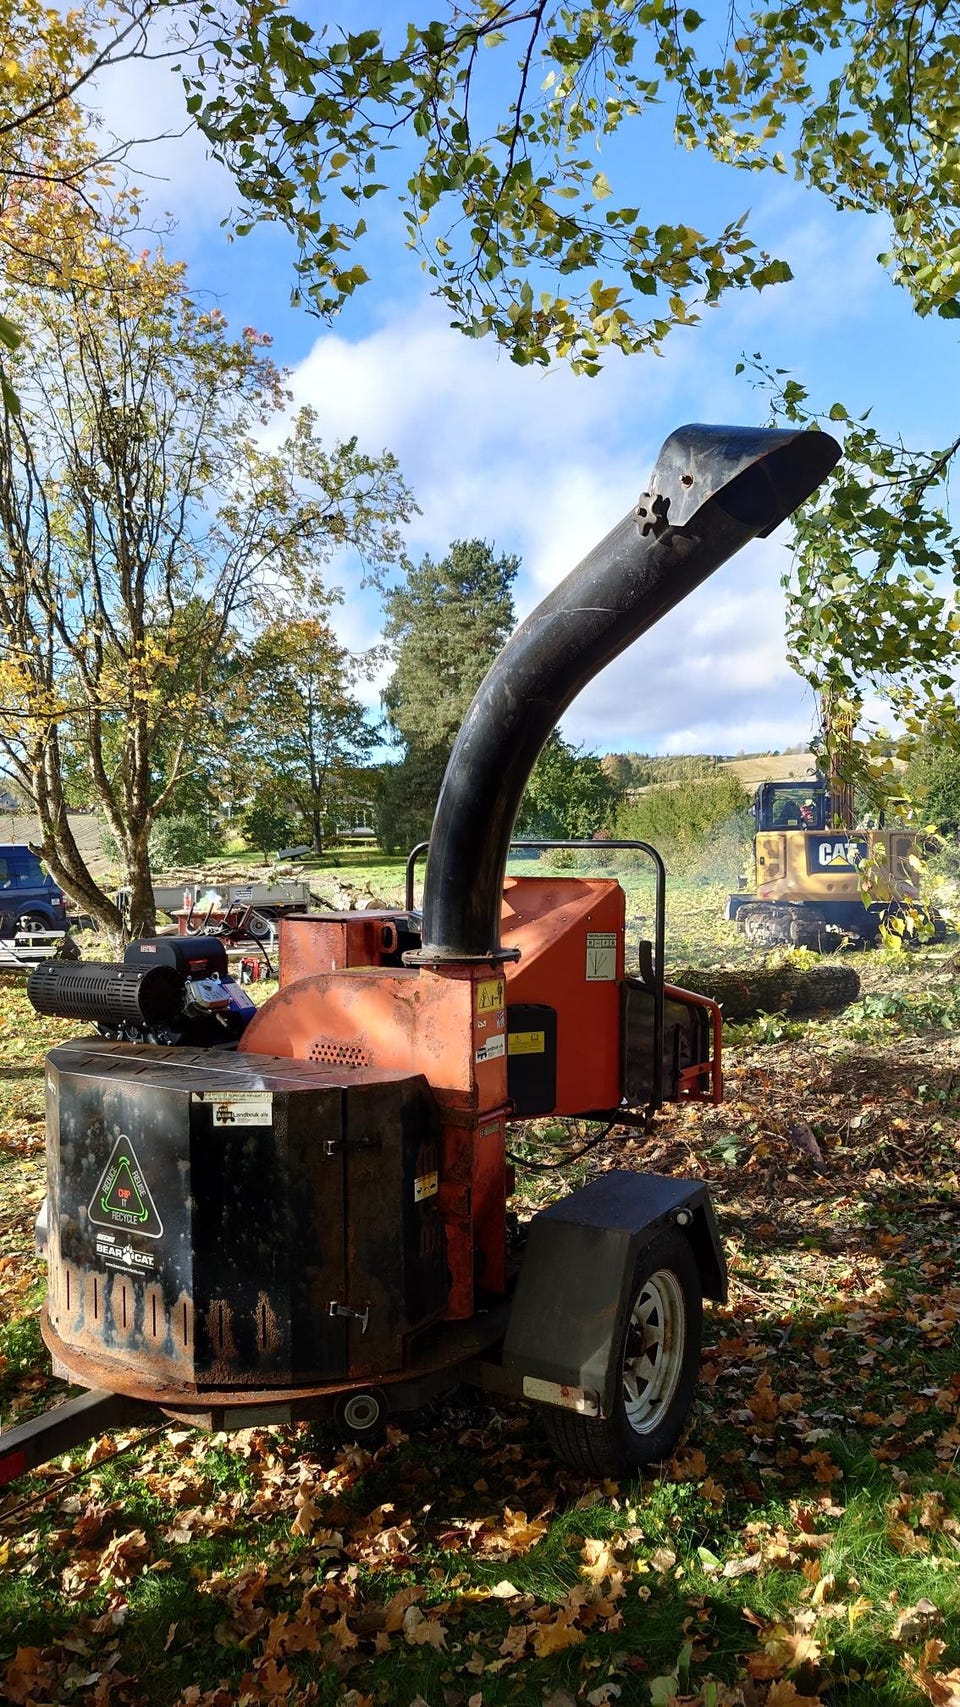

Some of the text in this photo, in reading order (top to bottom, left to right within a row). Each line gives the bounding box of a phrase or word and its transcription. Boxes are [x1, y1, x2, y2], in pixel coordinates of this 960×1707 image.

[132, 1170, 147, 1198] REUSE
[118, 1189, 131, 1199] CHIP
[121, 1199, 128, 1207] IT
[112, 1210, 138, 1225] RECYCLE
[96, 1243, 123, 1258] BEAR
